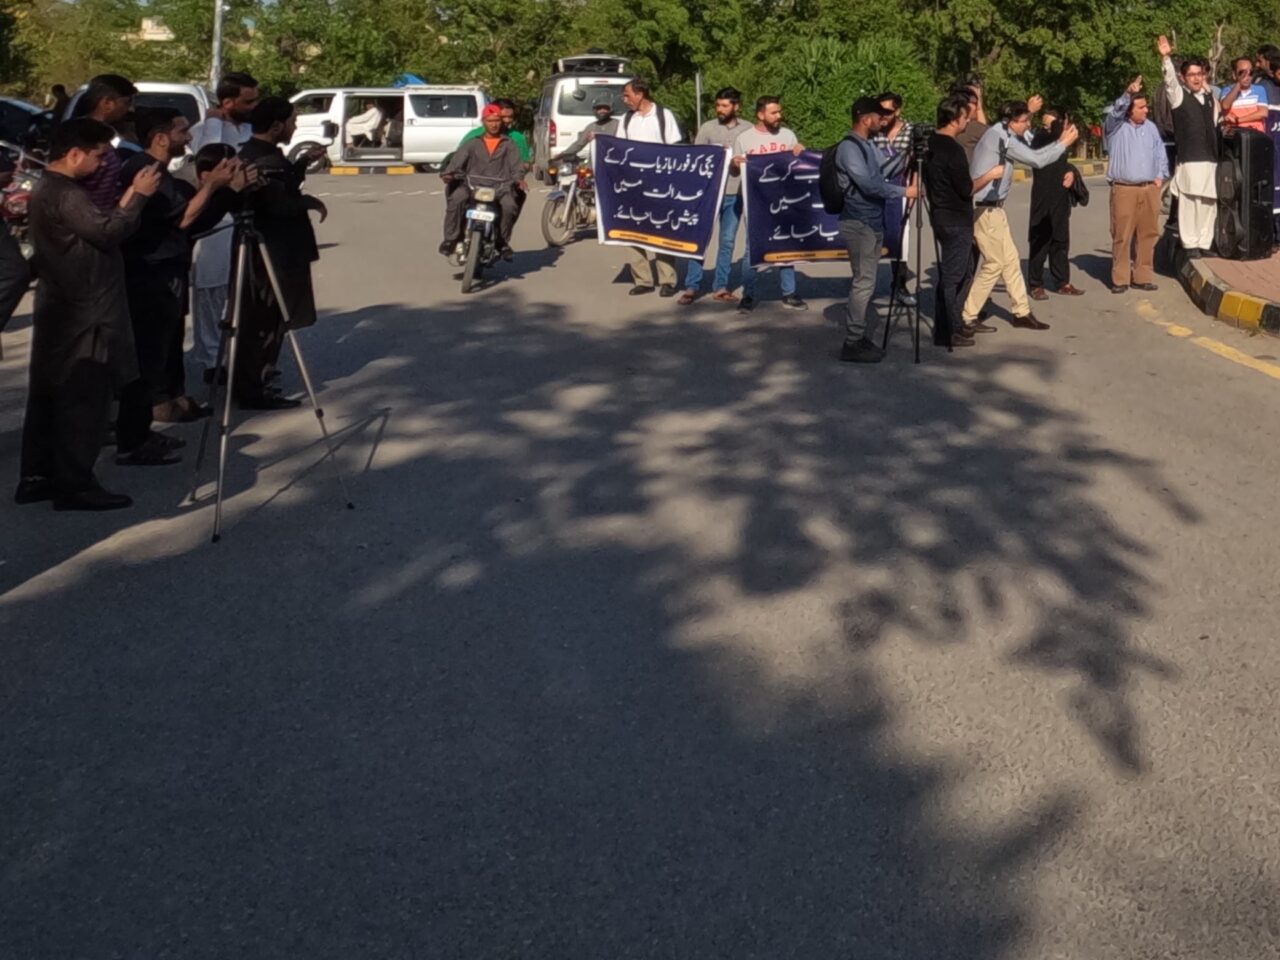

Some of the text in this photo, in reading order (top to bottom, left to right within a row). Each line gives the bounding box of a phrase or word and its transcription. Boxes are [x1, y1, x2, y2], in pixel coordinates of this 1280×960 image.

[689, 154, 705, 173] کو
[699, 154, 715, 179] بچی
[614, 179, 703, 201] عدالت میں
[770, 192, 811, 214] میں
[671, 208, 699, 230] پیش
